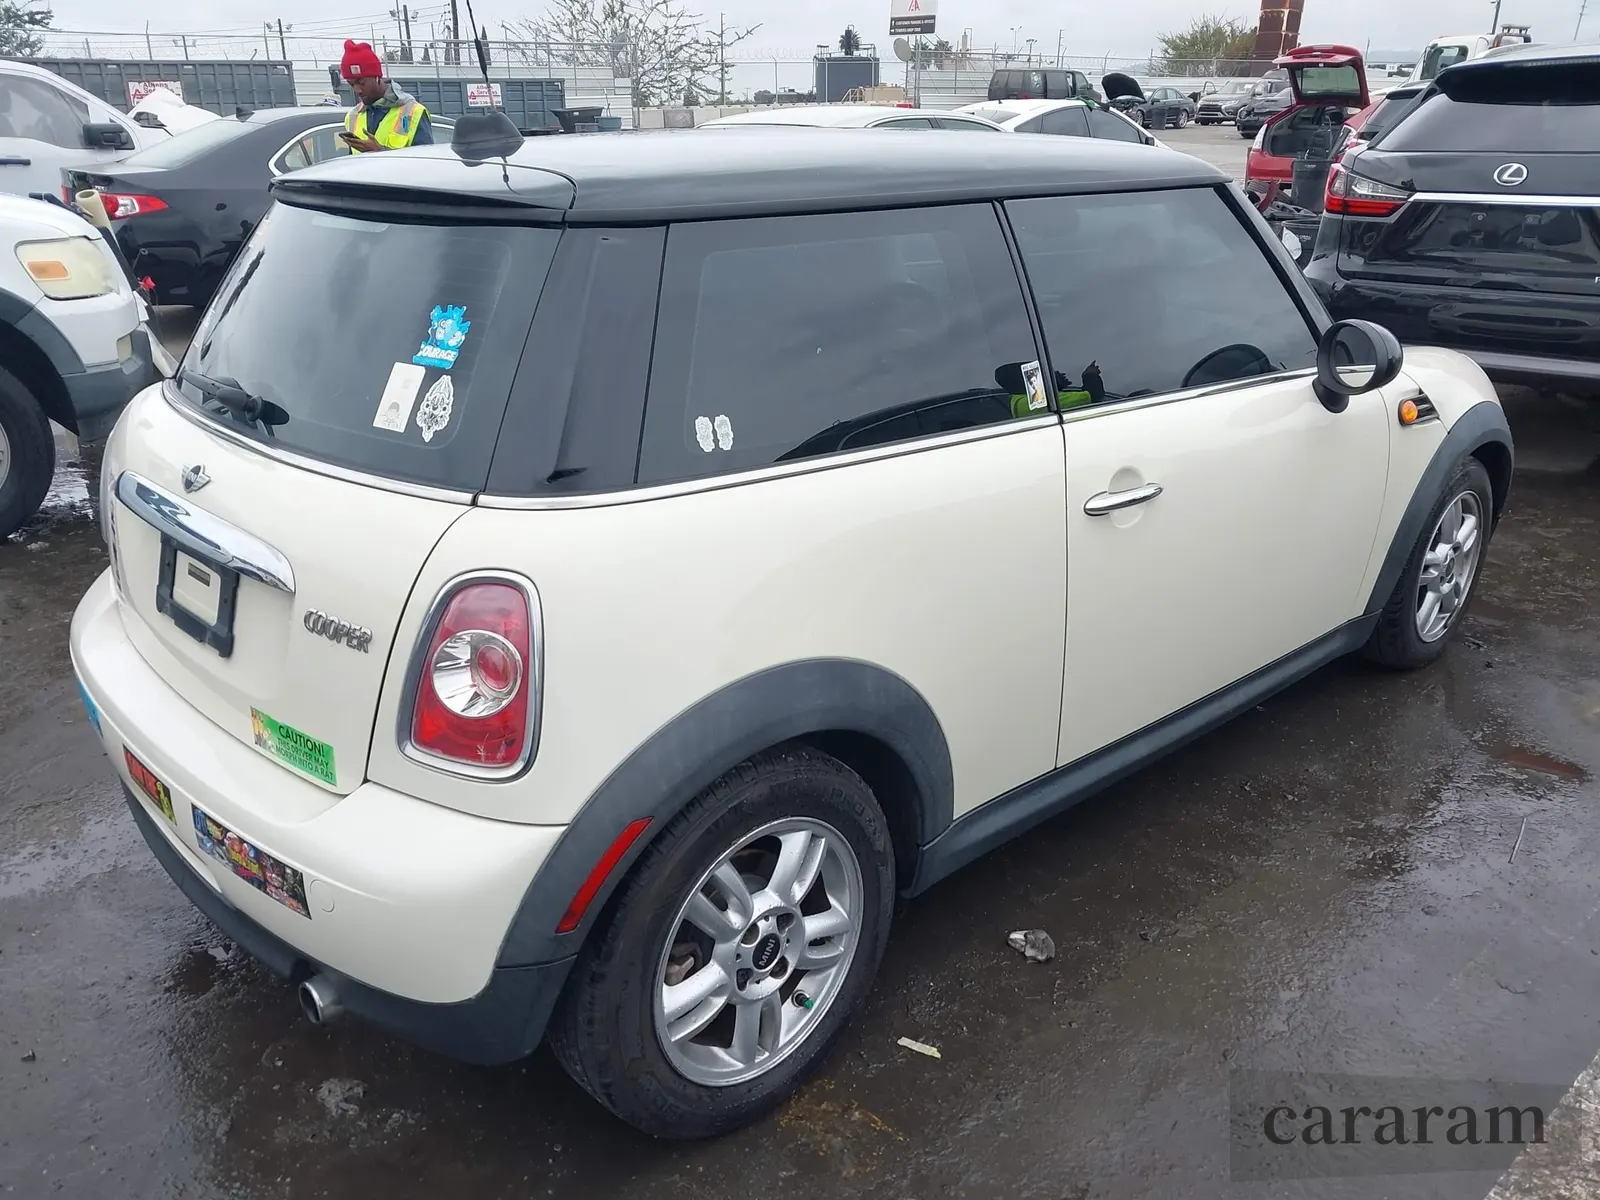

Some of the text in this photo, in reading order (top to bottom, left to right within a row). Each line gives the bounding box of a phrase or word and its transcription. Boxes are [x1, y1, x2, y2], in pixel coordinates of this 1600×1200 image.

[303, 608, 373, 654] COOPER
[277, 737, 329, 770] THIS DRIVER MAY
[278, 724, 325, 758] CAUTION!
[275, 744, 334, 781] MORPH INTO A RAT
[758, 939, 776, 967] MINI
